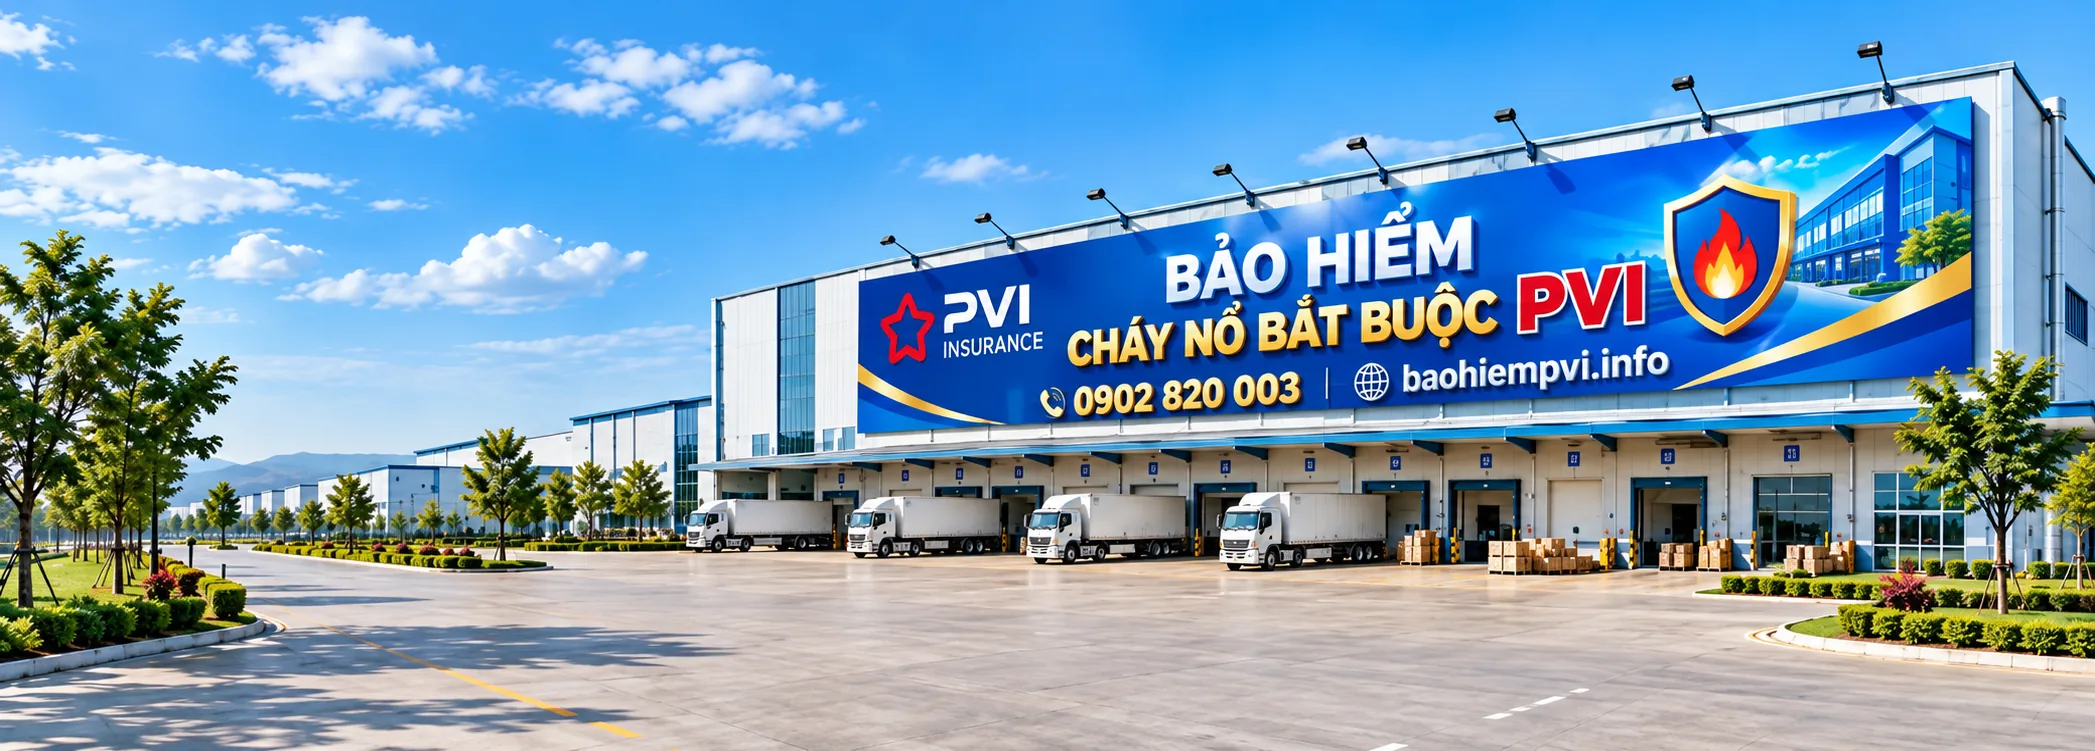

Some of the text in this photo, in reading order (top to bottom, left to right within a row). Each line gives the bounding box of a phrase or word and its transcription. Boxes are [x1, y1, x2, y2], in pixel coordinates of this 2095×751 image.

[1166, 201, 1476, 304] BẢO HIỂM
[944, 283, 1031, 334] PVI
[1067, 260, 1648, 367] CHÁY NỔ BẮT BUỘC PVI
[943, 331, 1044, 359] INSURANCE
[1403, 344, 1670, 393] baohiempvi.info
[1073, 371, 1301, 416] 0902 820 003
